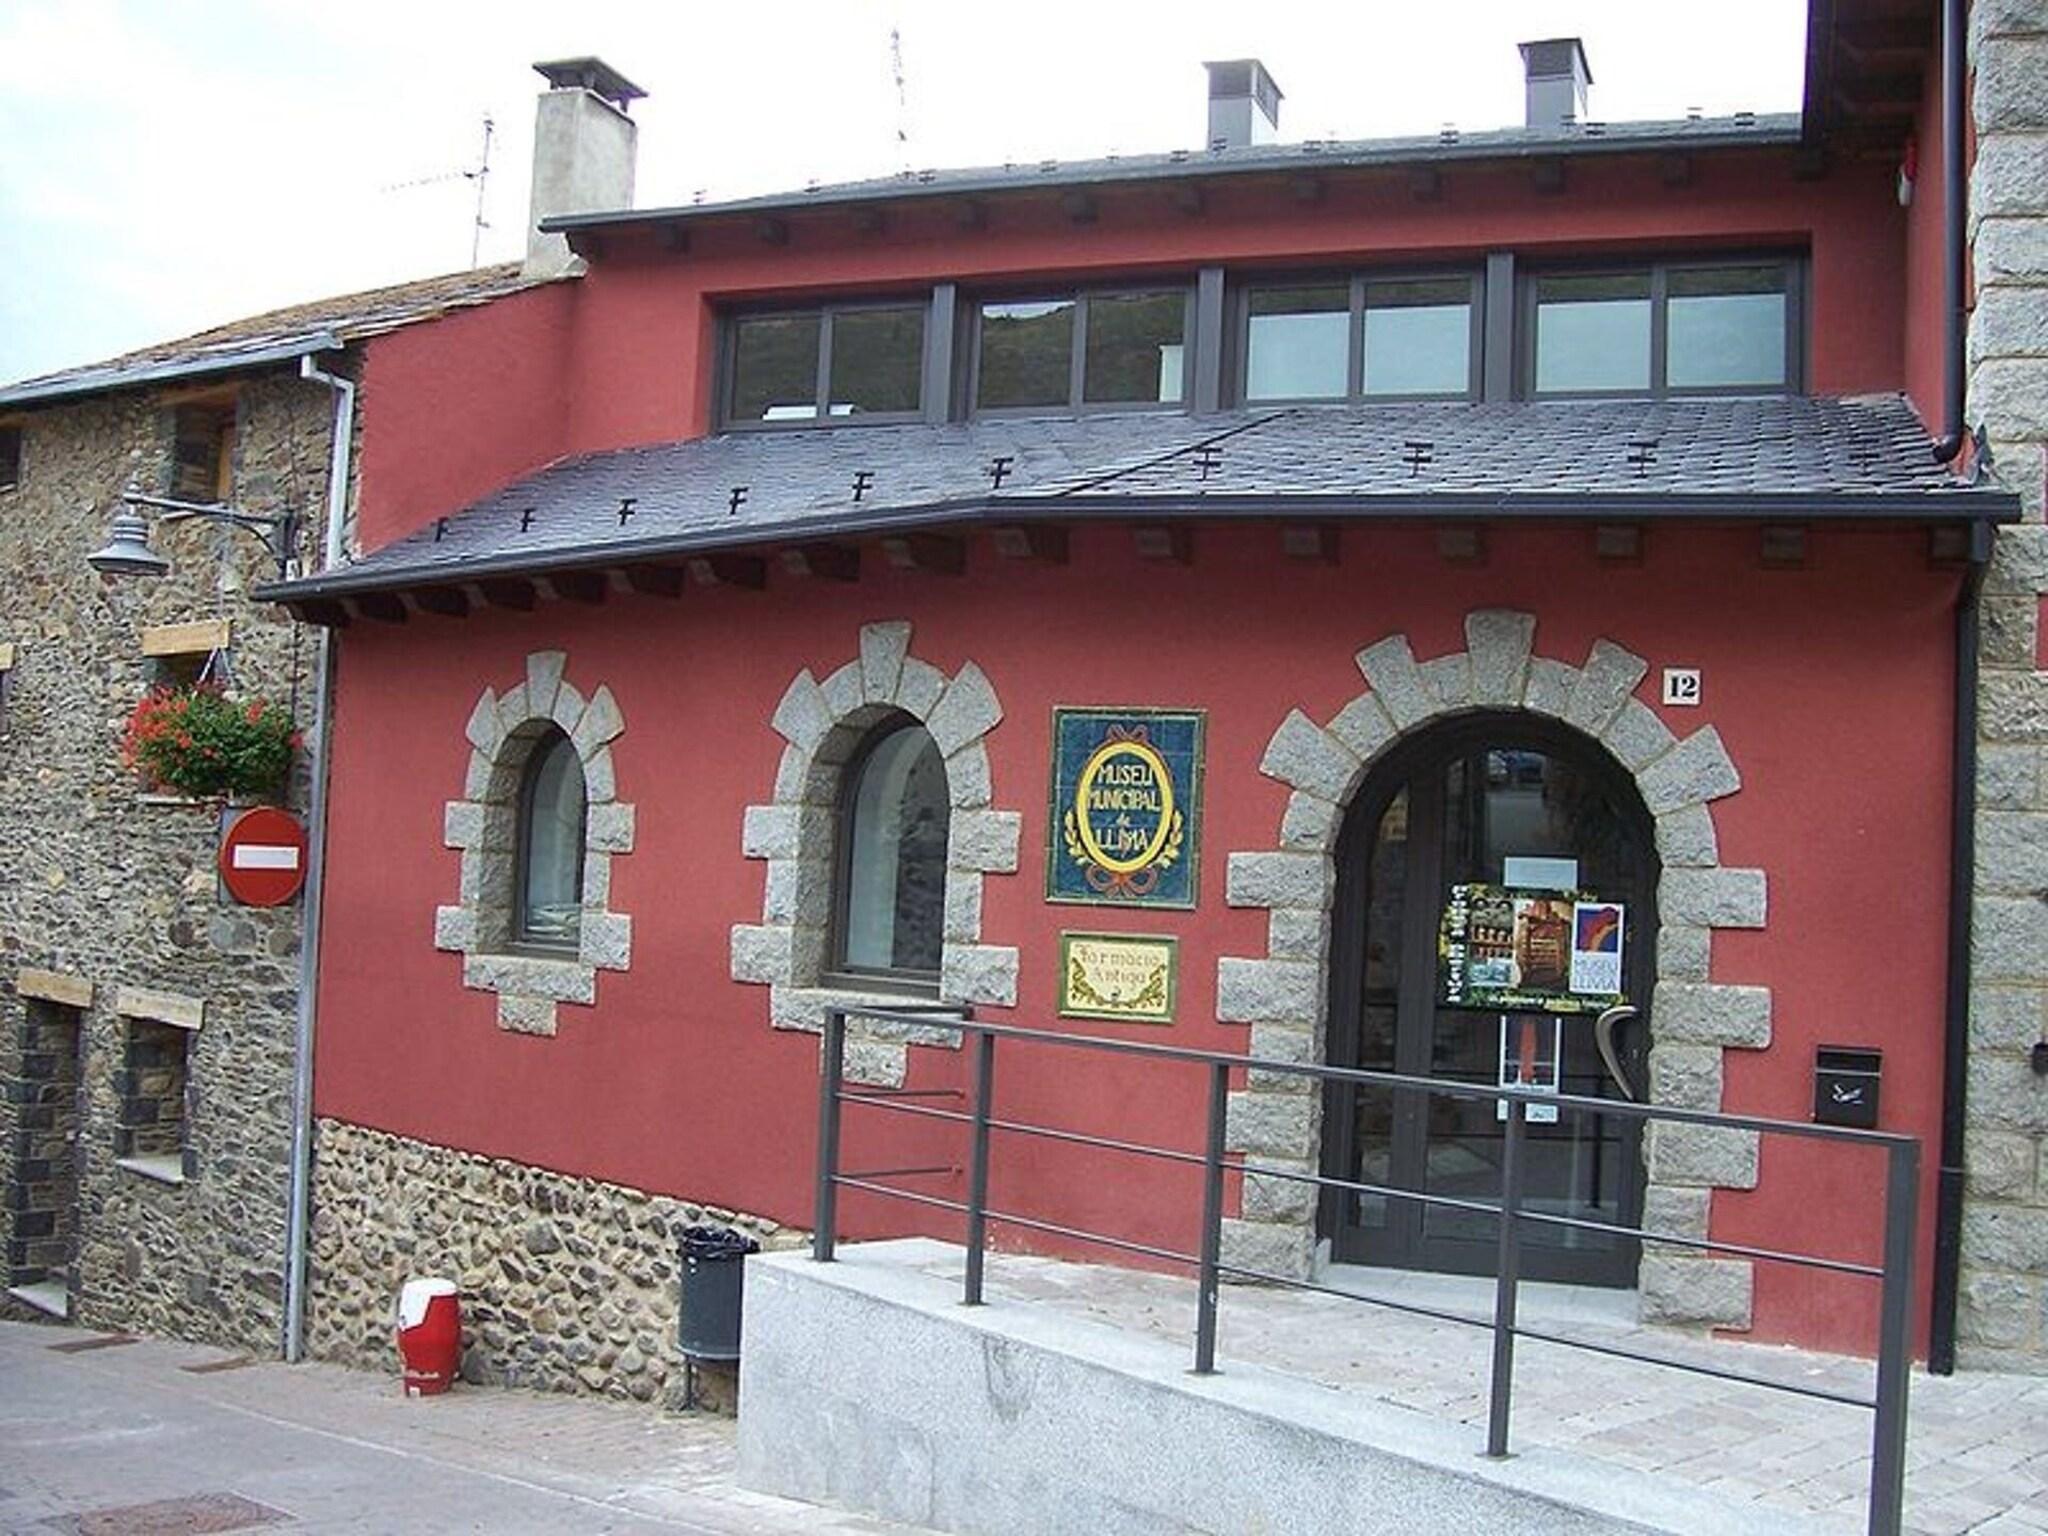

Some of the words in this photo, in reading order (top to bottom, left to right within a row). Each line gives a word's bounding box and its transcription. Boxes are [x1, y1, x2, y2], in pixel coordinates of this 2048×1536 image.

[1671, 675, 1697, 697] 12
[1097, 764, 1153, 786] MUSEU
[1087, 789, 1161, 811] MUNICIPAL
